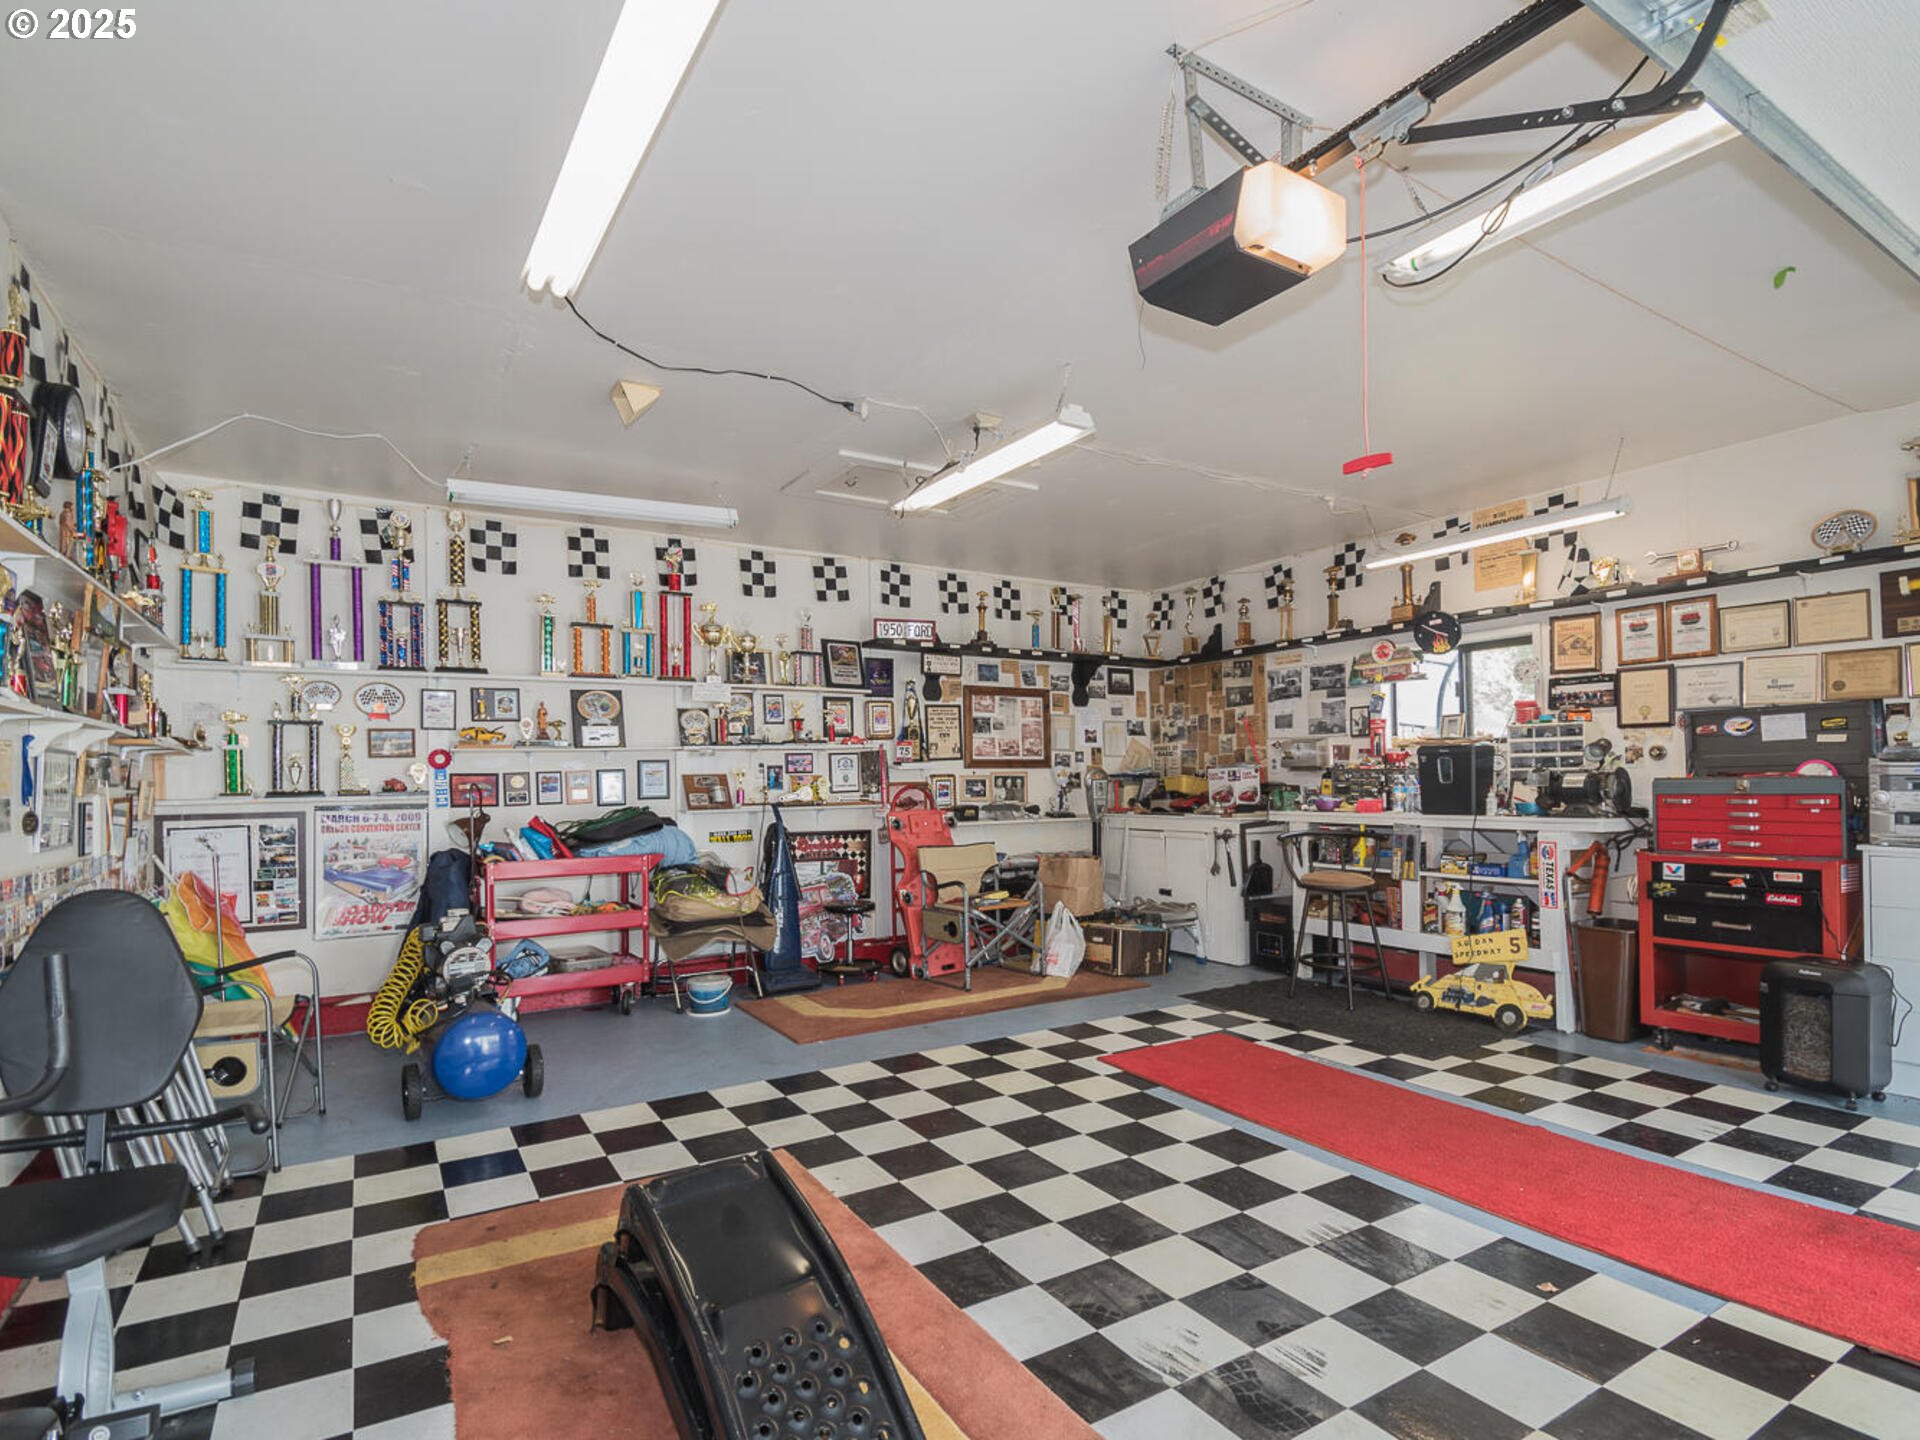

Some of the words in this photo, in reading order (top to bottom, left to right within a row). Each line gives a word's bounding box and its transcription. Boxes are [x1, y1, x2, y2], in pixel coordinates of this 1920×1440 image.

[879, 623, 903, 637] 1950
[907, 624, 933, 639] FORD
[899, 746, 911, 757] 75
[321, 813, 360, 824] MARCH
[351, 823, 395, 834] CONVENTION
[395, 822, 421, 833] CENTER
[1545, 861, 1555, 890] TEXAS
[333, 913, 389, 926] SHOW
[1509, 937, 1521, 954] 5
[1453, 947, 1503, 959] SPEEDWAY
